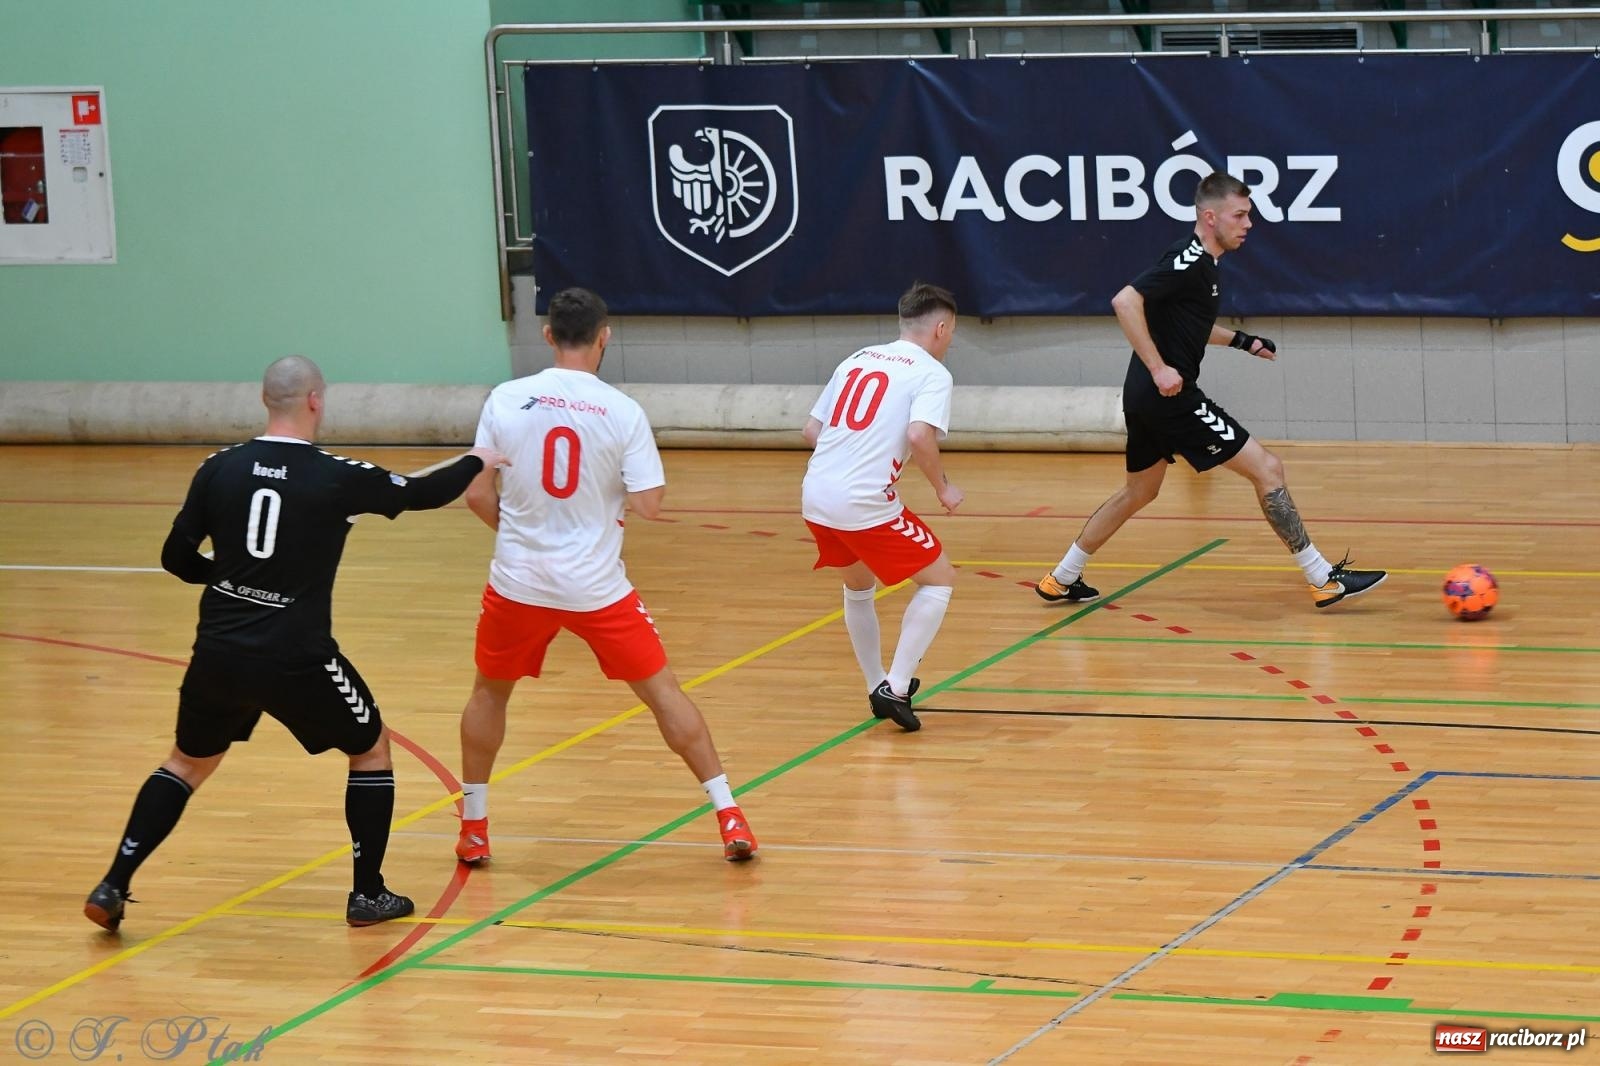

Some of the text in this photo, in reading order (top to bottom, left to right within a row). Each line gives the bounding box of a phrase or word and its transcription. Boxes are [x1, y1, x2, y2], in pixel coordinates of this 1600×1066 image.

[884, 130, 1341, 222] RACIBÓRZ
[539, 396, 607, 416] PRD KÜHN
[830, 367, 889, 431] 10
[542, 426, 581, 499] 0
[246, 488, 282, 559] 0
